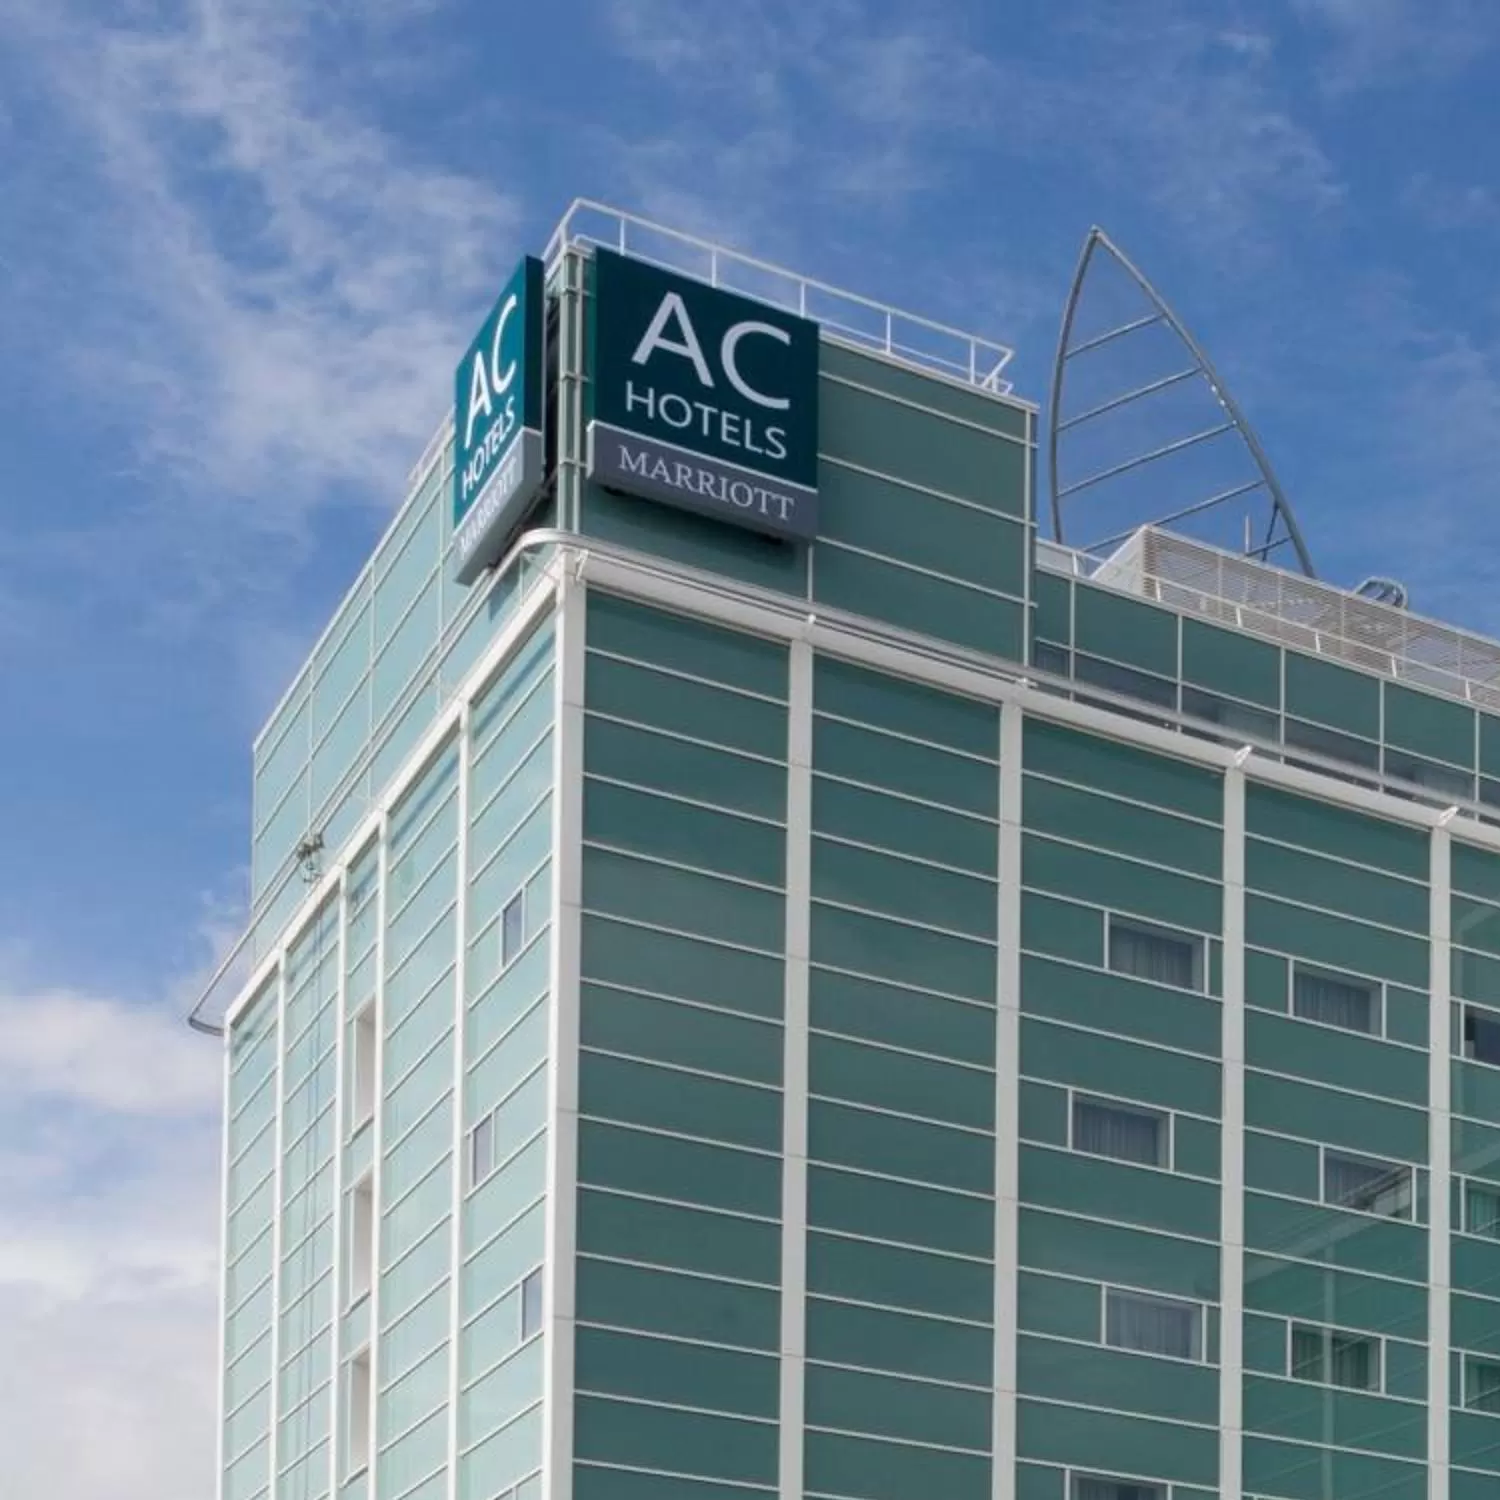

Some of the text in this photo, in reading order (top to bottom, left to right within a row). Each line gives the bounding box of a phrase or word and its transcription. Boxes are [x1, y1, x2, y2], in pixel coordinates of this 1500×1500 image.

[464, 293, 517, 450] AC
[631, 291, 791, 410] AC
[462, 395, 516, 501] HOTELS
[626, 380, 788, 460] HOTELS
[618, 444, 796, 521] MARRIOTT
